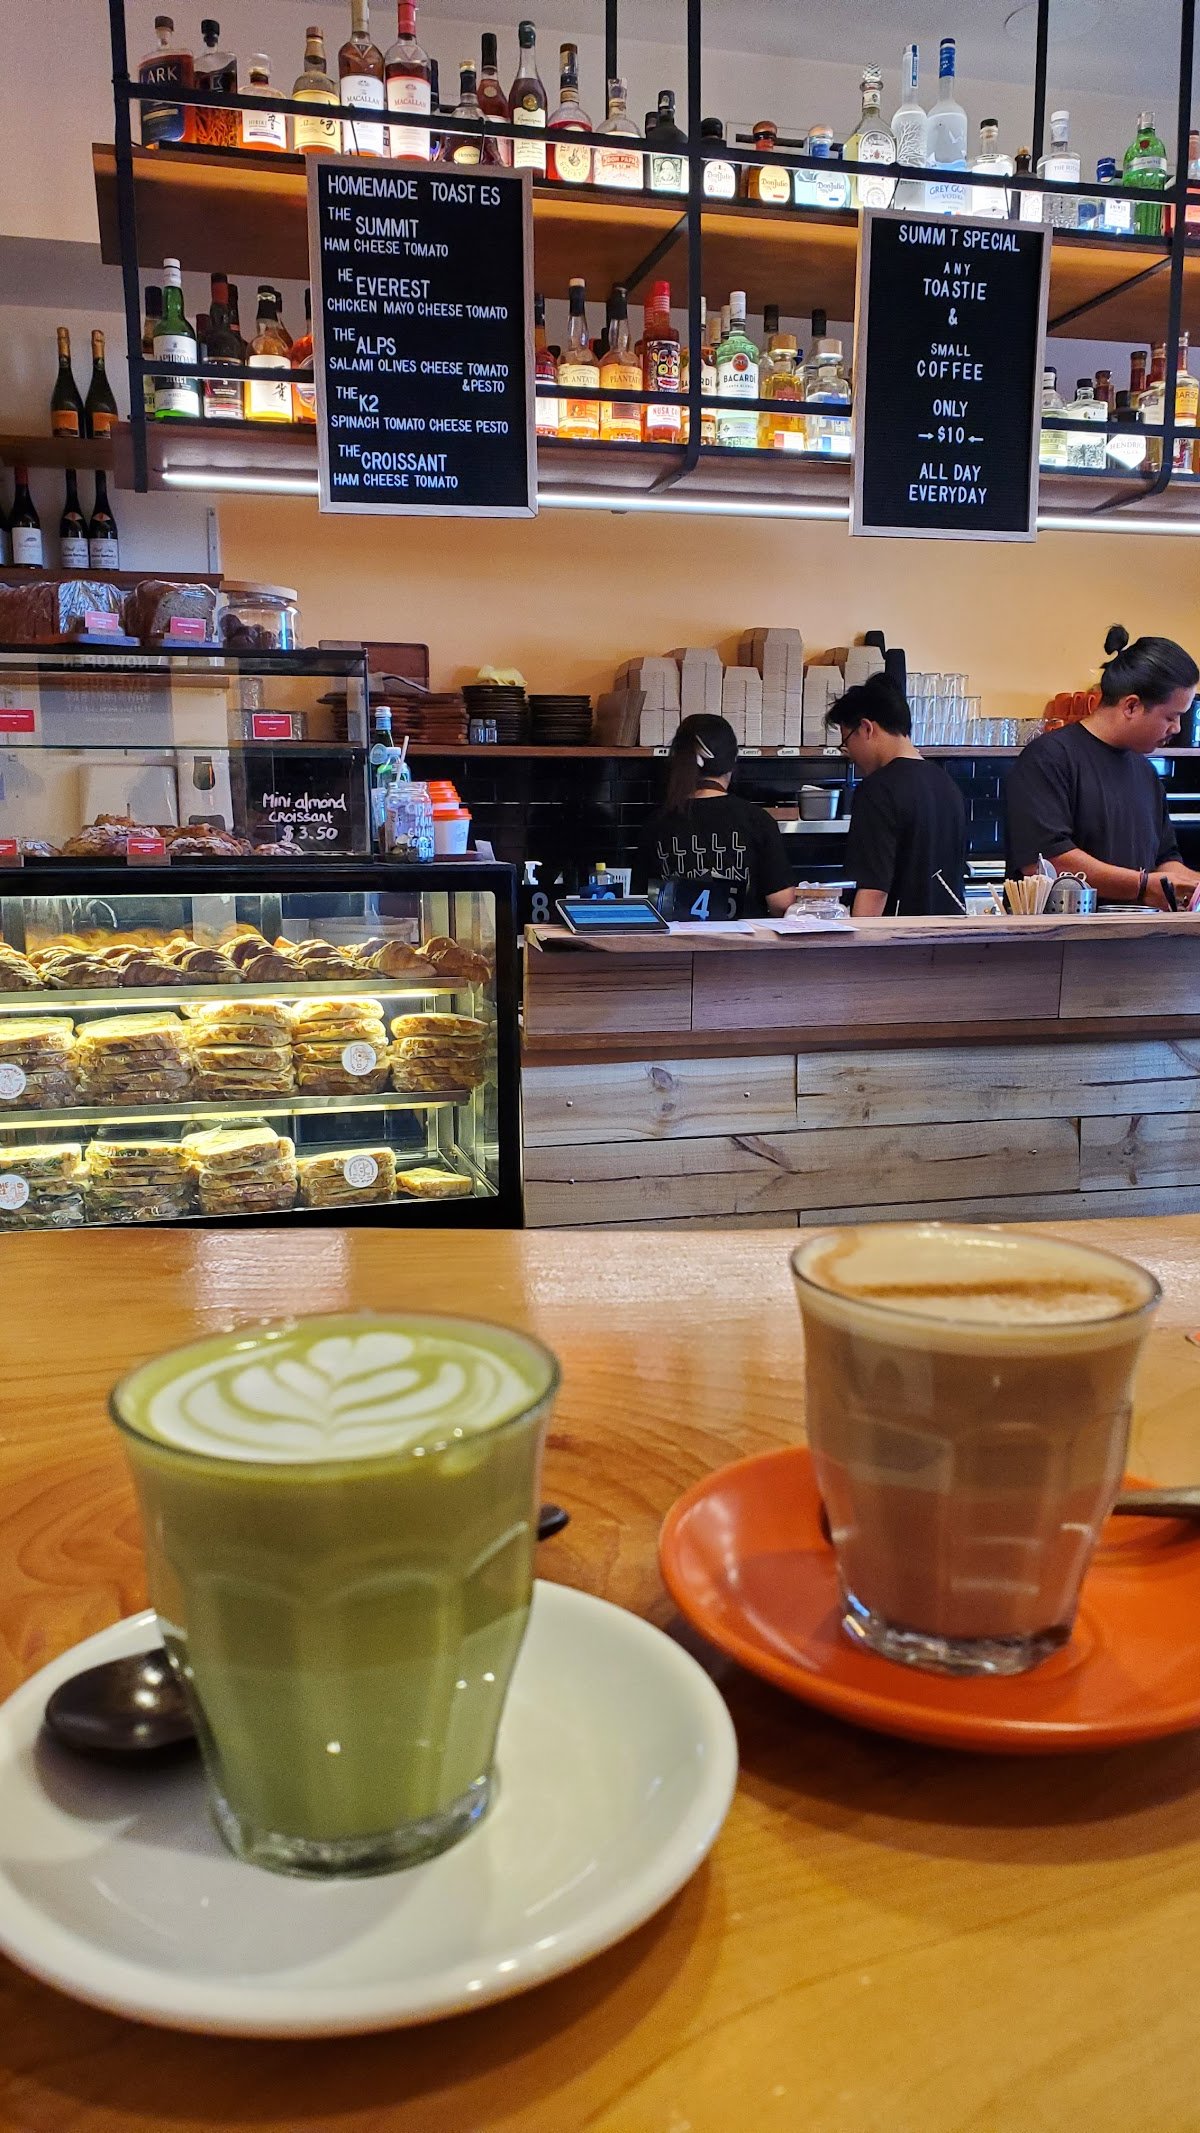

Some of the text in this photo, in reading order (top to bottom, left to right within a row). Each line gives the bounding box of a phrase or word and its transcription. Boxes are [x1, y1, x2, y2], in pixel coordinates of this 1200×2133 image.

[328, 175, 418, 200] HOMEMADE
[930, 184, 949, 195] GREY
[328, 207, 419, 238] THE SUMMIT
[324, 237, 449, 258] HAM CHEESE TOMATO
[962, 230, 1021, 252] SPECIAL
[943, 262, 971, 276] ANY
[356, 277, 430, 299] EVEREST
[923, 278, 988, 301] TOASTIE
[327, 299, 508, 320] CHICKEN MAYO CHEESE TOMATO
[948, 307, 958, 326] &
[333, 327, 397, 356] THE ALPS
[930, 343, 971, 358] SMALL
[329, 357, 509, 377] SALAMI OLIVES CHEESE TOMATO
[916, 360, 984, 381] COFFEE
[336, 386, 379, 413] THE K2
[932, 399, 968, 418] ONLY
[331, 415, 509, 434] SPINACH TOMATO CHEESE PESTO
[937, 425, 965, 444] $10
[338, 444, 448, 473] THE CROISSANT
[333, 472, 459, 489] HAM CHEESE TOMATO
[919, 462, 982, 483] ALL DAY
[908, 485, 988, 505] EVERYDAY
[262, 791, 348, 812] Mini almond
[299, 826, 339, 841] 3.50
[690, 889, 711, 921] 4
